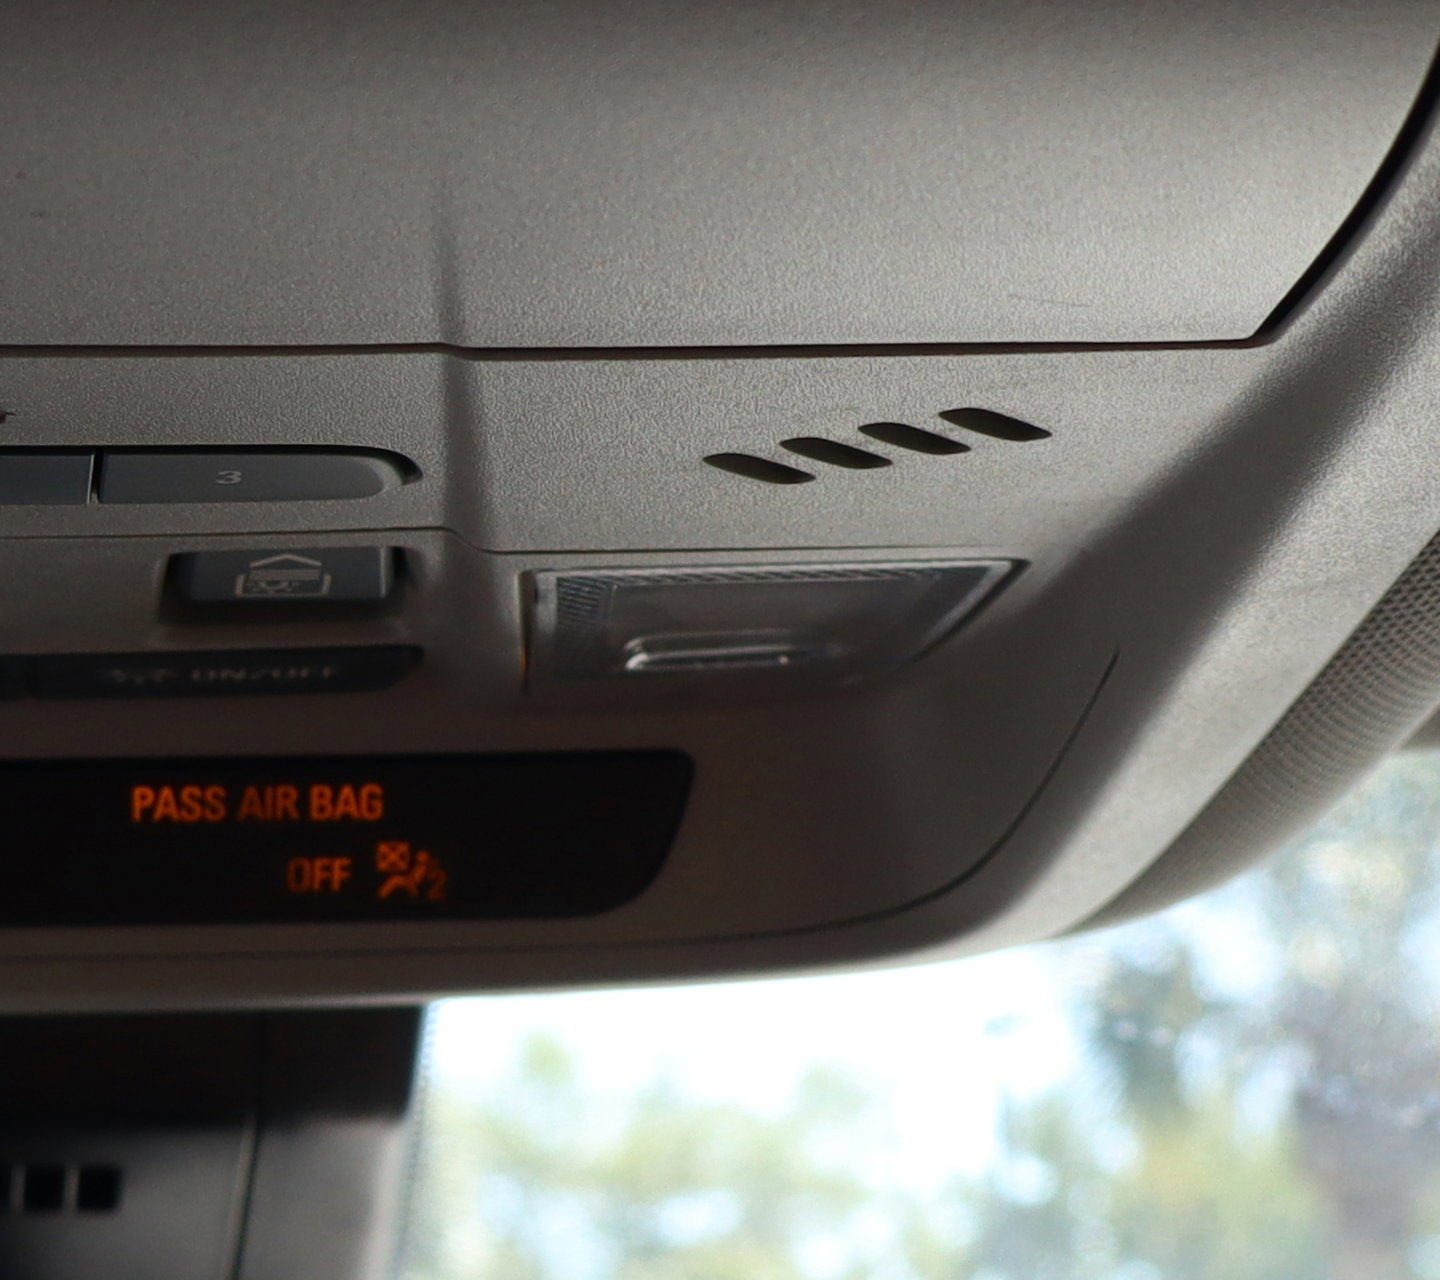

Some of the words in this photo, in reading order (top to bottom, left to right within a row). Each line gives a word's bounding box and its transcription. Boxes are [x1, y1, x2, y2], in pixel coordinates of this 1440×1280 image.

[215, 470, 243, 485] 3
[131, 783, 229, 823] PASS
[238, 784, 299, 822] AIR
[308, 782, 385, 822] BAG
[285, 854, 354, 893] OFF
